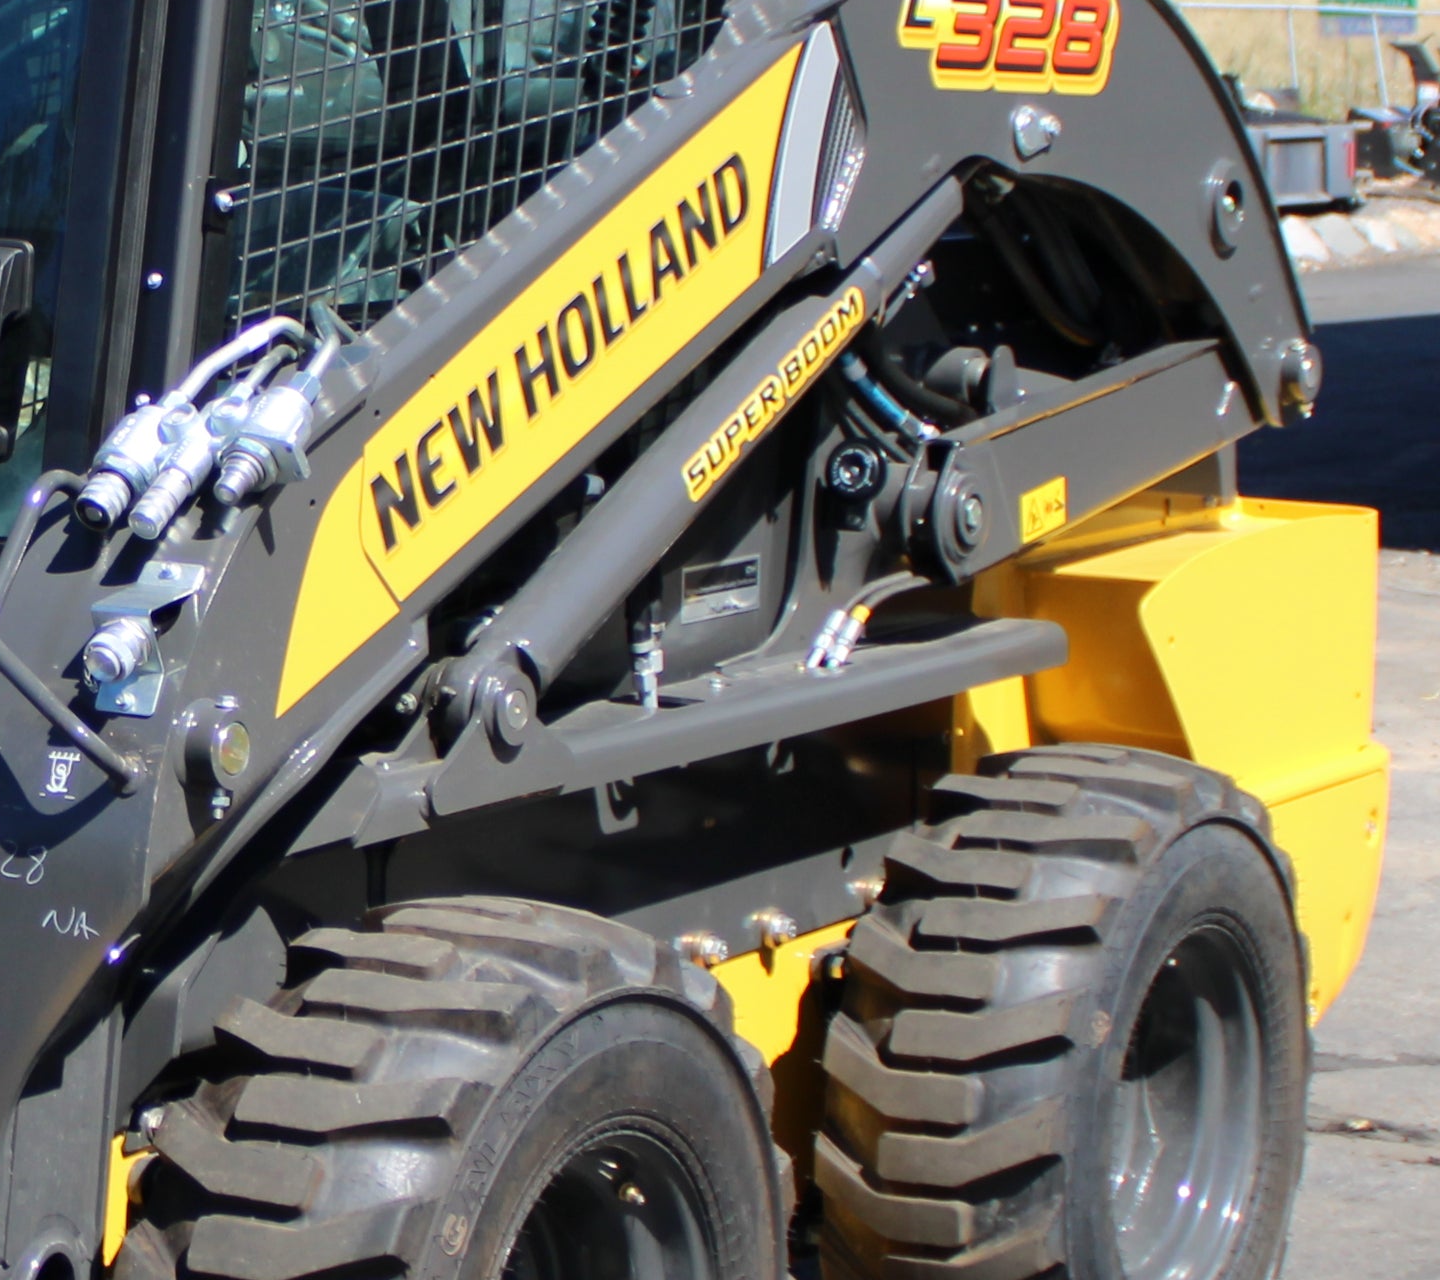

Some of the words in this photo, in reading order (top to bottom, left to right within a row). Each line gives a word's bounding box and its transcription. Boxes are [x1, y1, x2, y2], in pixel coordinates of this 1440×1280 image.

[370, 366, 505, 554] NEW
[514, 151, 750, 420] HOLLAND
[685, 380, 780, 494] SUPER
[782, 290, 861, 389] BOOM
